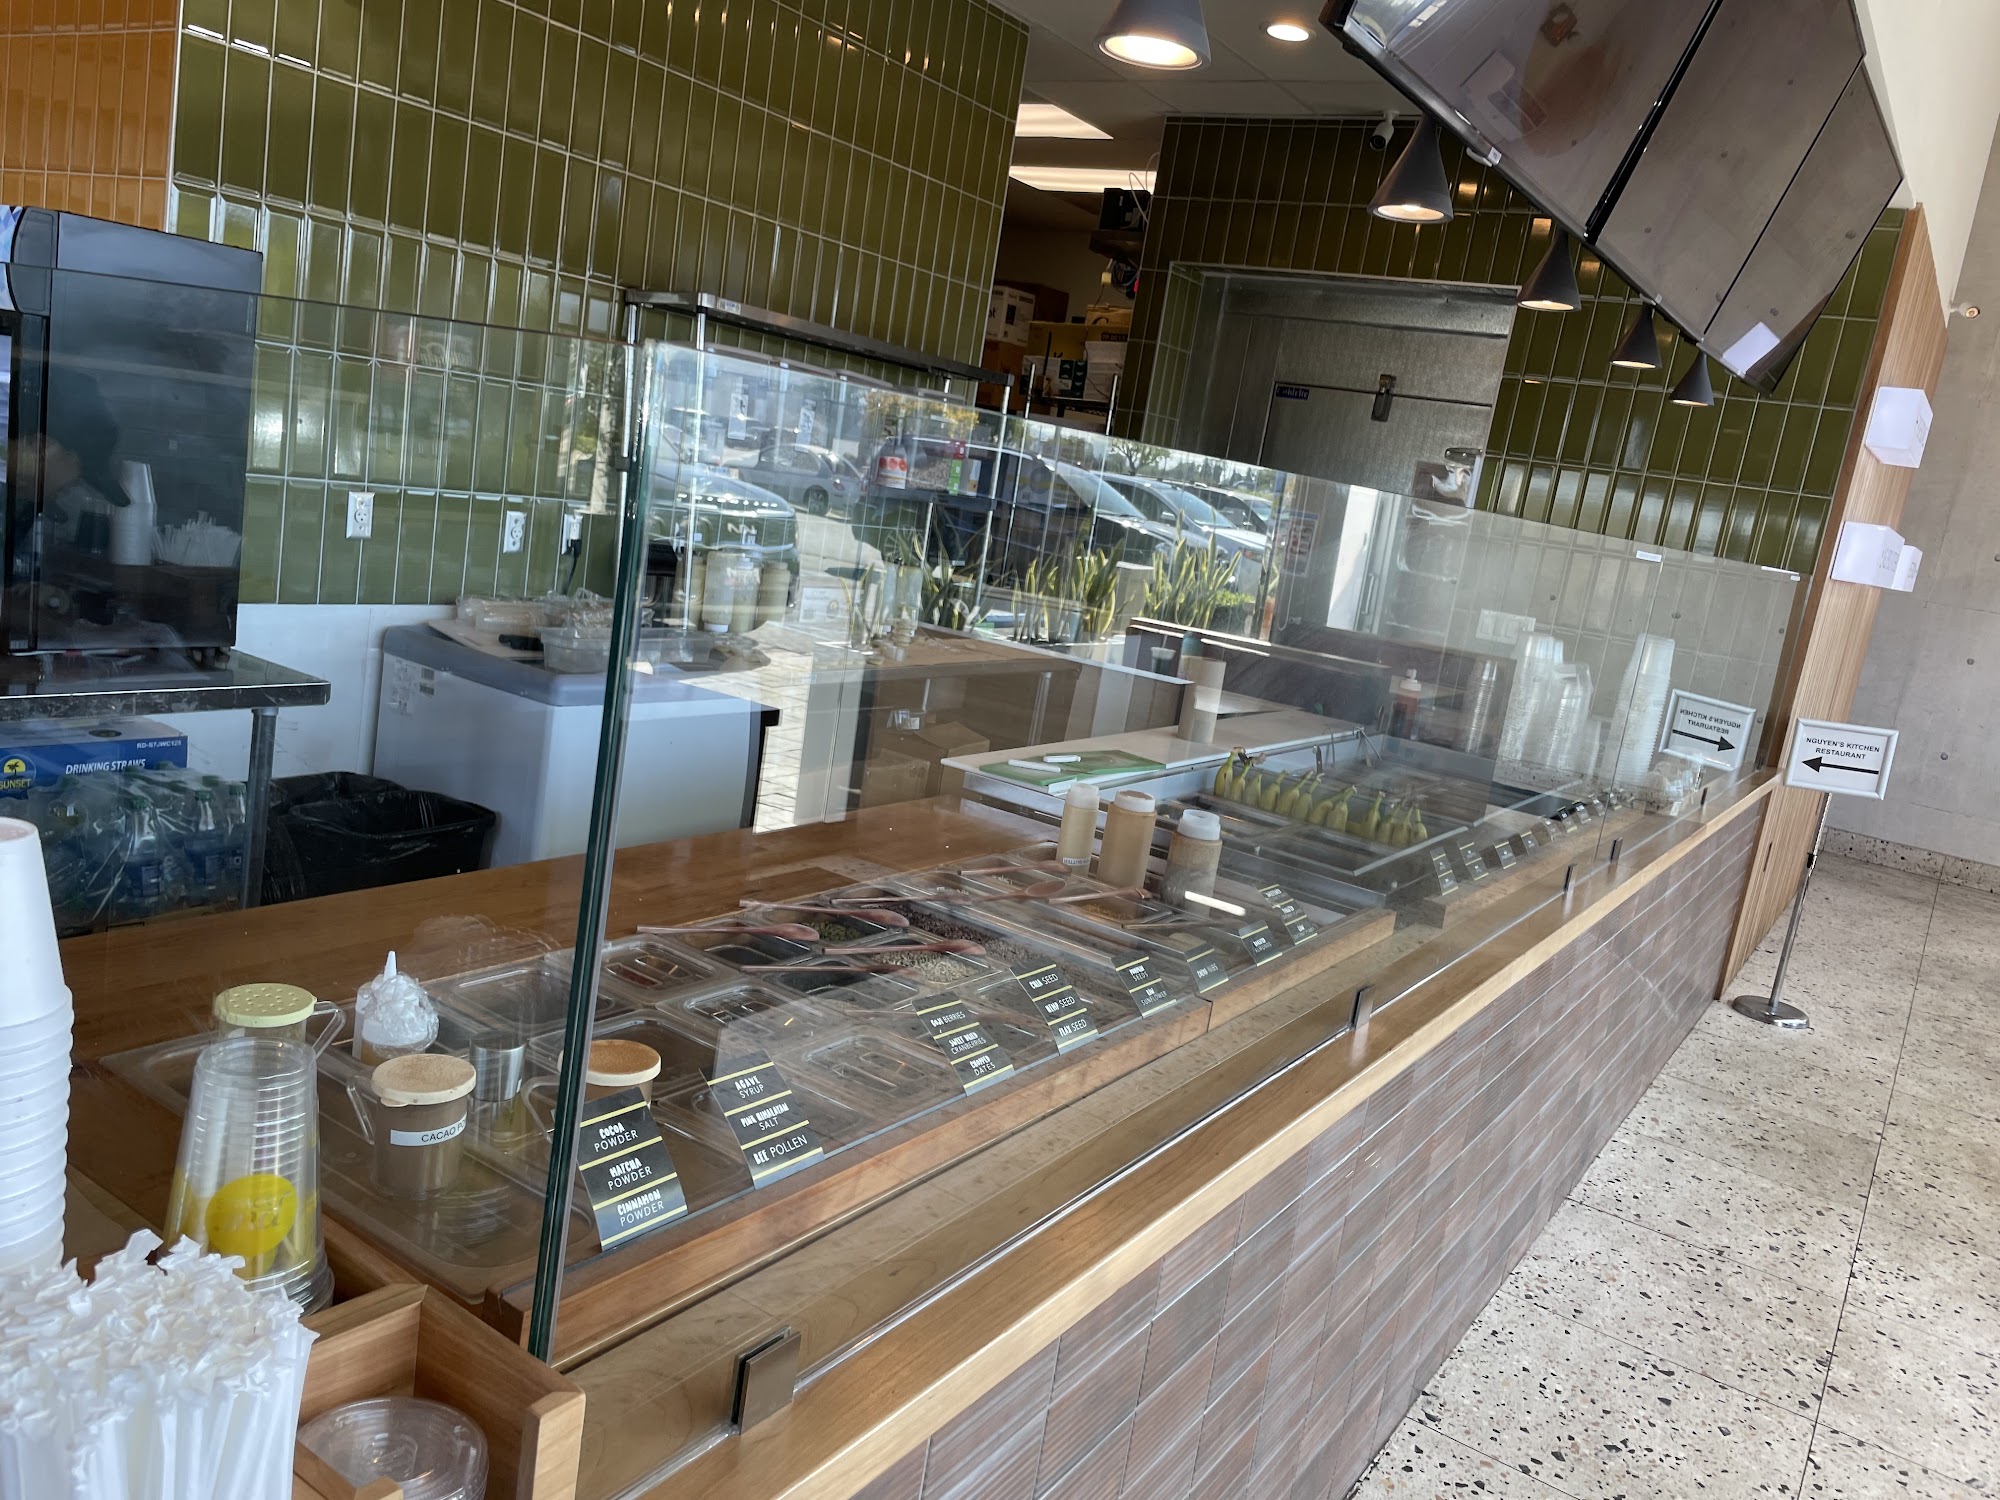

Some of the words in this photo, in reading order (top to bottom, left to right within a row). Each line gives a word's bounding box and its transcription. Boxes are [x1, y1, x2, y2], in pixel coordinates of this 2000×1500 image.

[1805, 737, 1845, 748] NGUYEN'S
[1847, 742, 1880, 753] KITCHEN
[1815, 748, 1866, 760] RESTAURANT
[65, 761, 110, 775] DRINKING
[110, 758, 146, 772] STRAWS
[0, 778, 31, 790] SUNSET
[1042, 973, 1059, 985] SEED
[1132, 971, 1149, 982] SEEDS
[1058, 996, 1076, 1008] SEED
[1140, 990, 1168, 1006] SUNFLOWER
[942, 1011, 966, 1024] BERRIES
[1058, 1024, 1073, 1038] FLAX
[1071, 1018, 1087, 1032] SEED
[950, 1037, 987, 1055] CRANBERRIES
[973, 1061, 996, 1076] DATES
[734, 1075, 761, 1091] AGAVE
[739, 1084, 764, 1099] SYRUP
[740, 1114, 758, 1128] PINK
[755, 1102, 790, 1122] HIMALAYAN
[598, 1122, 625, 1139] COCOA
[759, 1116, 779, 1131] SALT
[421, 1126, 457, 1143] CACAO
[594, 1129, 639, 1153] POWDER
[753, 1149, 770, 1165] BEE
[769, 1134, 808, 1158] POLLEN
[609, 1157, 642, 1178] MATCHA
[607, 1165, 653, 1191] POWDER
[617, 1188, 661, 1216] CINNAMON
[620, 1200, 665, 1227] POWDER
